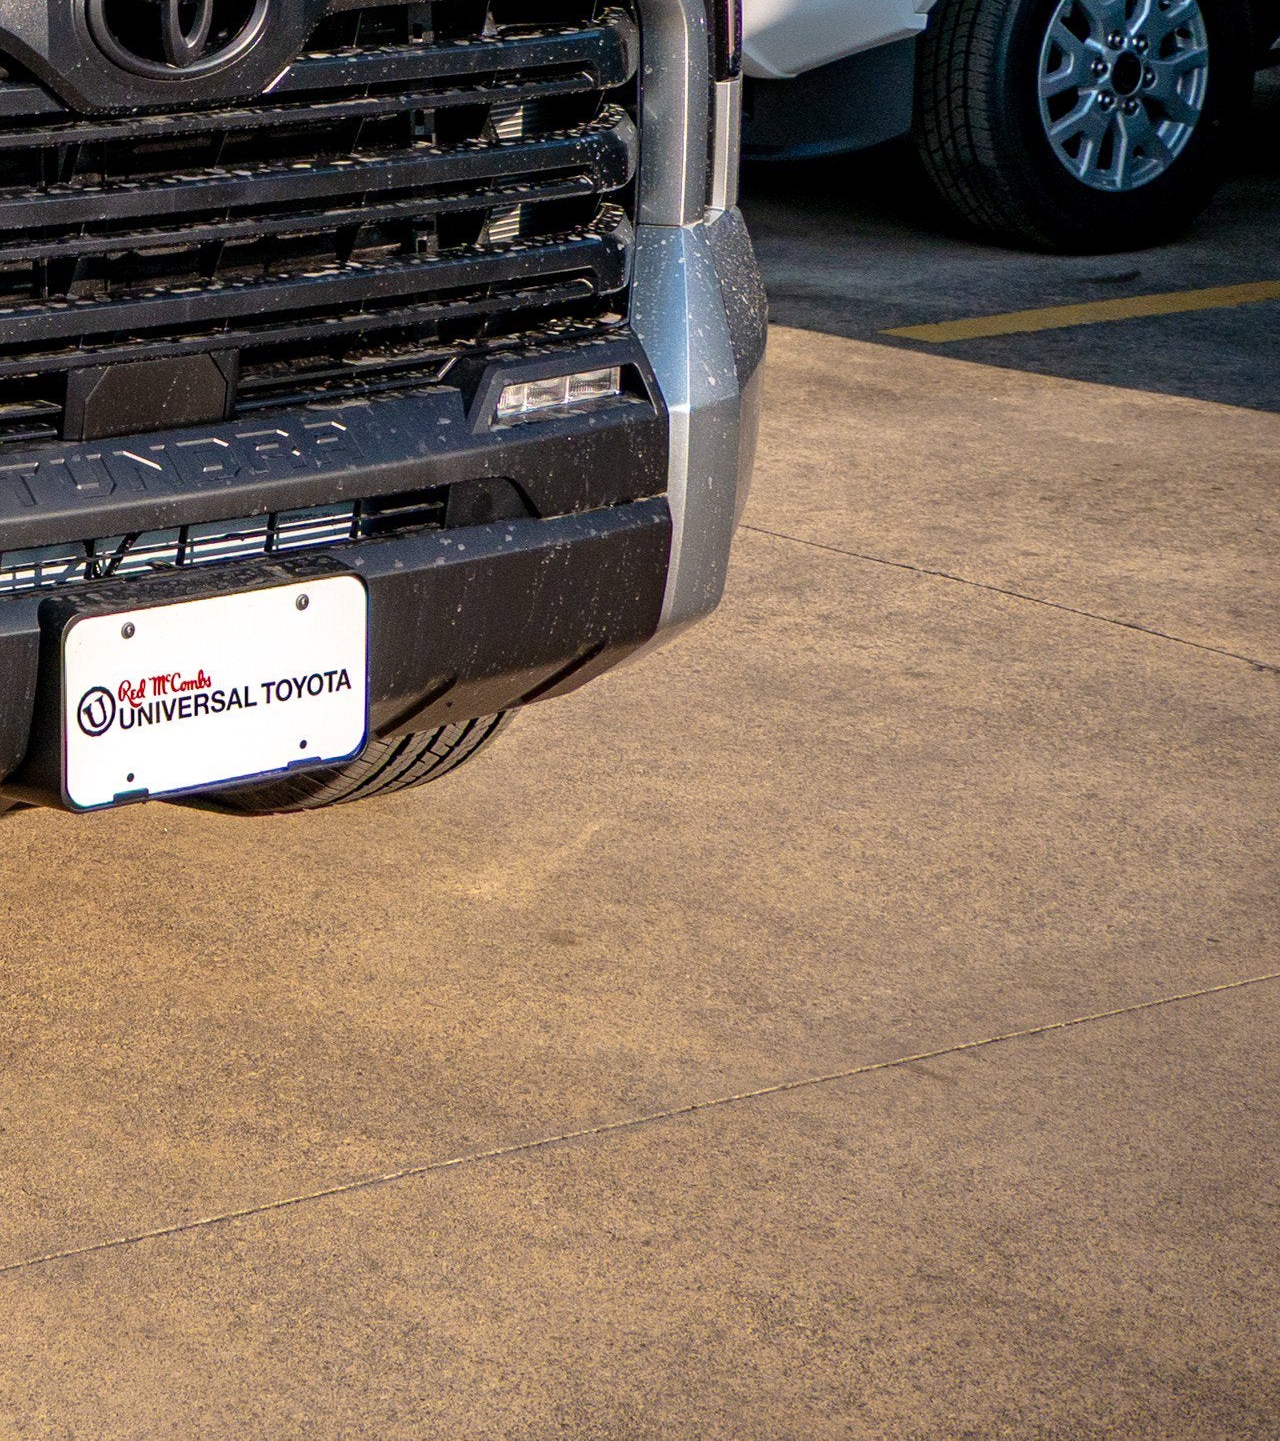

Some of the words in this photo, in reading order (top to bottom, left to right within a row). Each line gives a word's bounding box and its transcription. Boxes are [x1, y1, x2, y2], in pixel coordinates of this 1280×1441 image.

[118, 679, 146, 708] Red
[148, 669, 212, 697] McCombs
[119, 688, 257, 729] UNIVERSAL
[261, 668, 352, 704] TOYOTA
